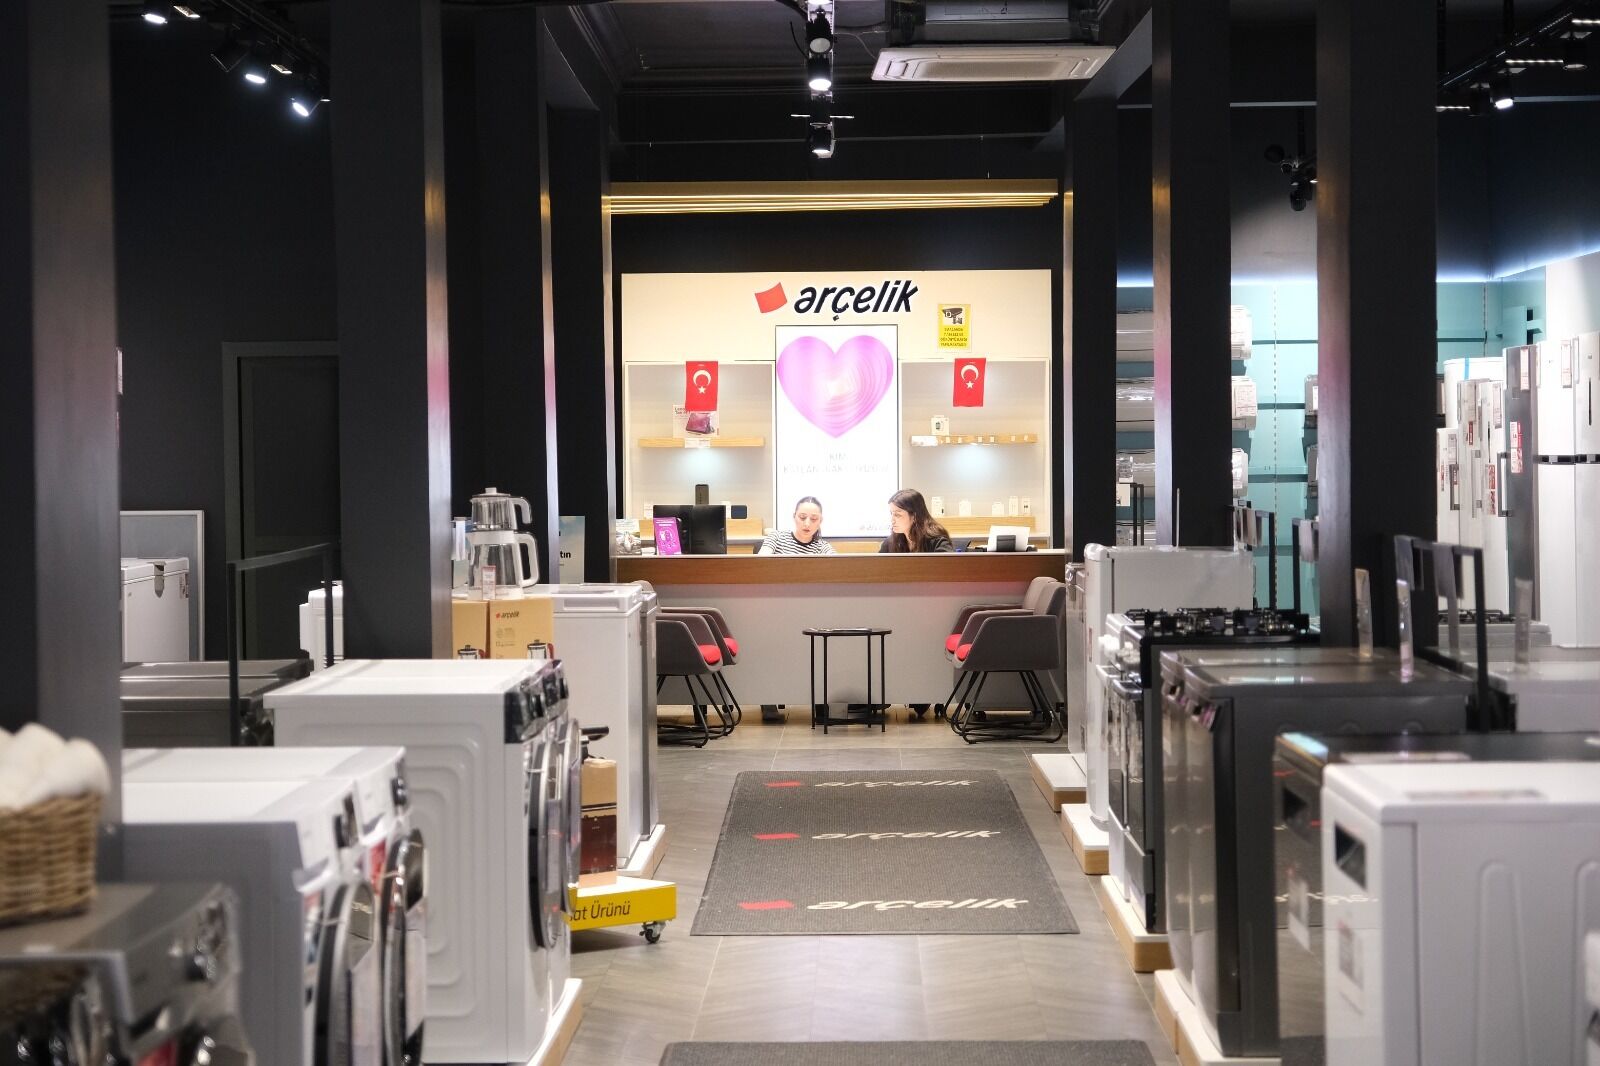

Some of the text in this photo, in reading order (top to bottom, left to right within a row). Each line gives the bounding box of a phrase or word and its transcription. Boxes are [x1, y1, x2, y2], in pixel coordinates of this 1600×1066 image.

[794, 280, 918, 321] arçelik
[815, 780, 979, 788] arçelik
[812, 830, 1001, 840] arçelik
[591, 900, 631, 919] Ürünü
[807, 898, 1029, 911] arçelik
